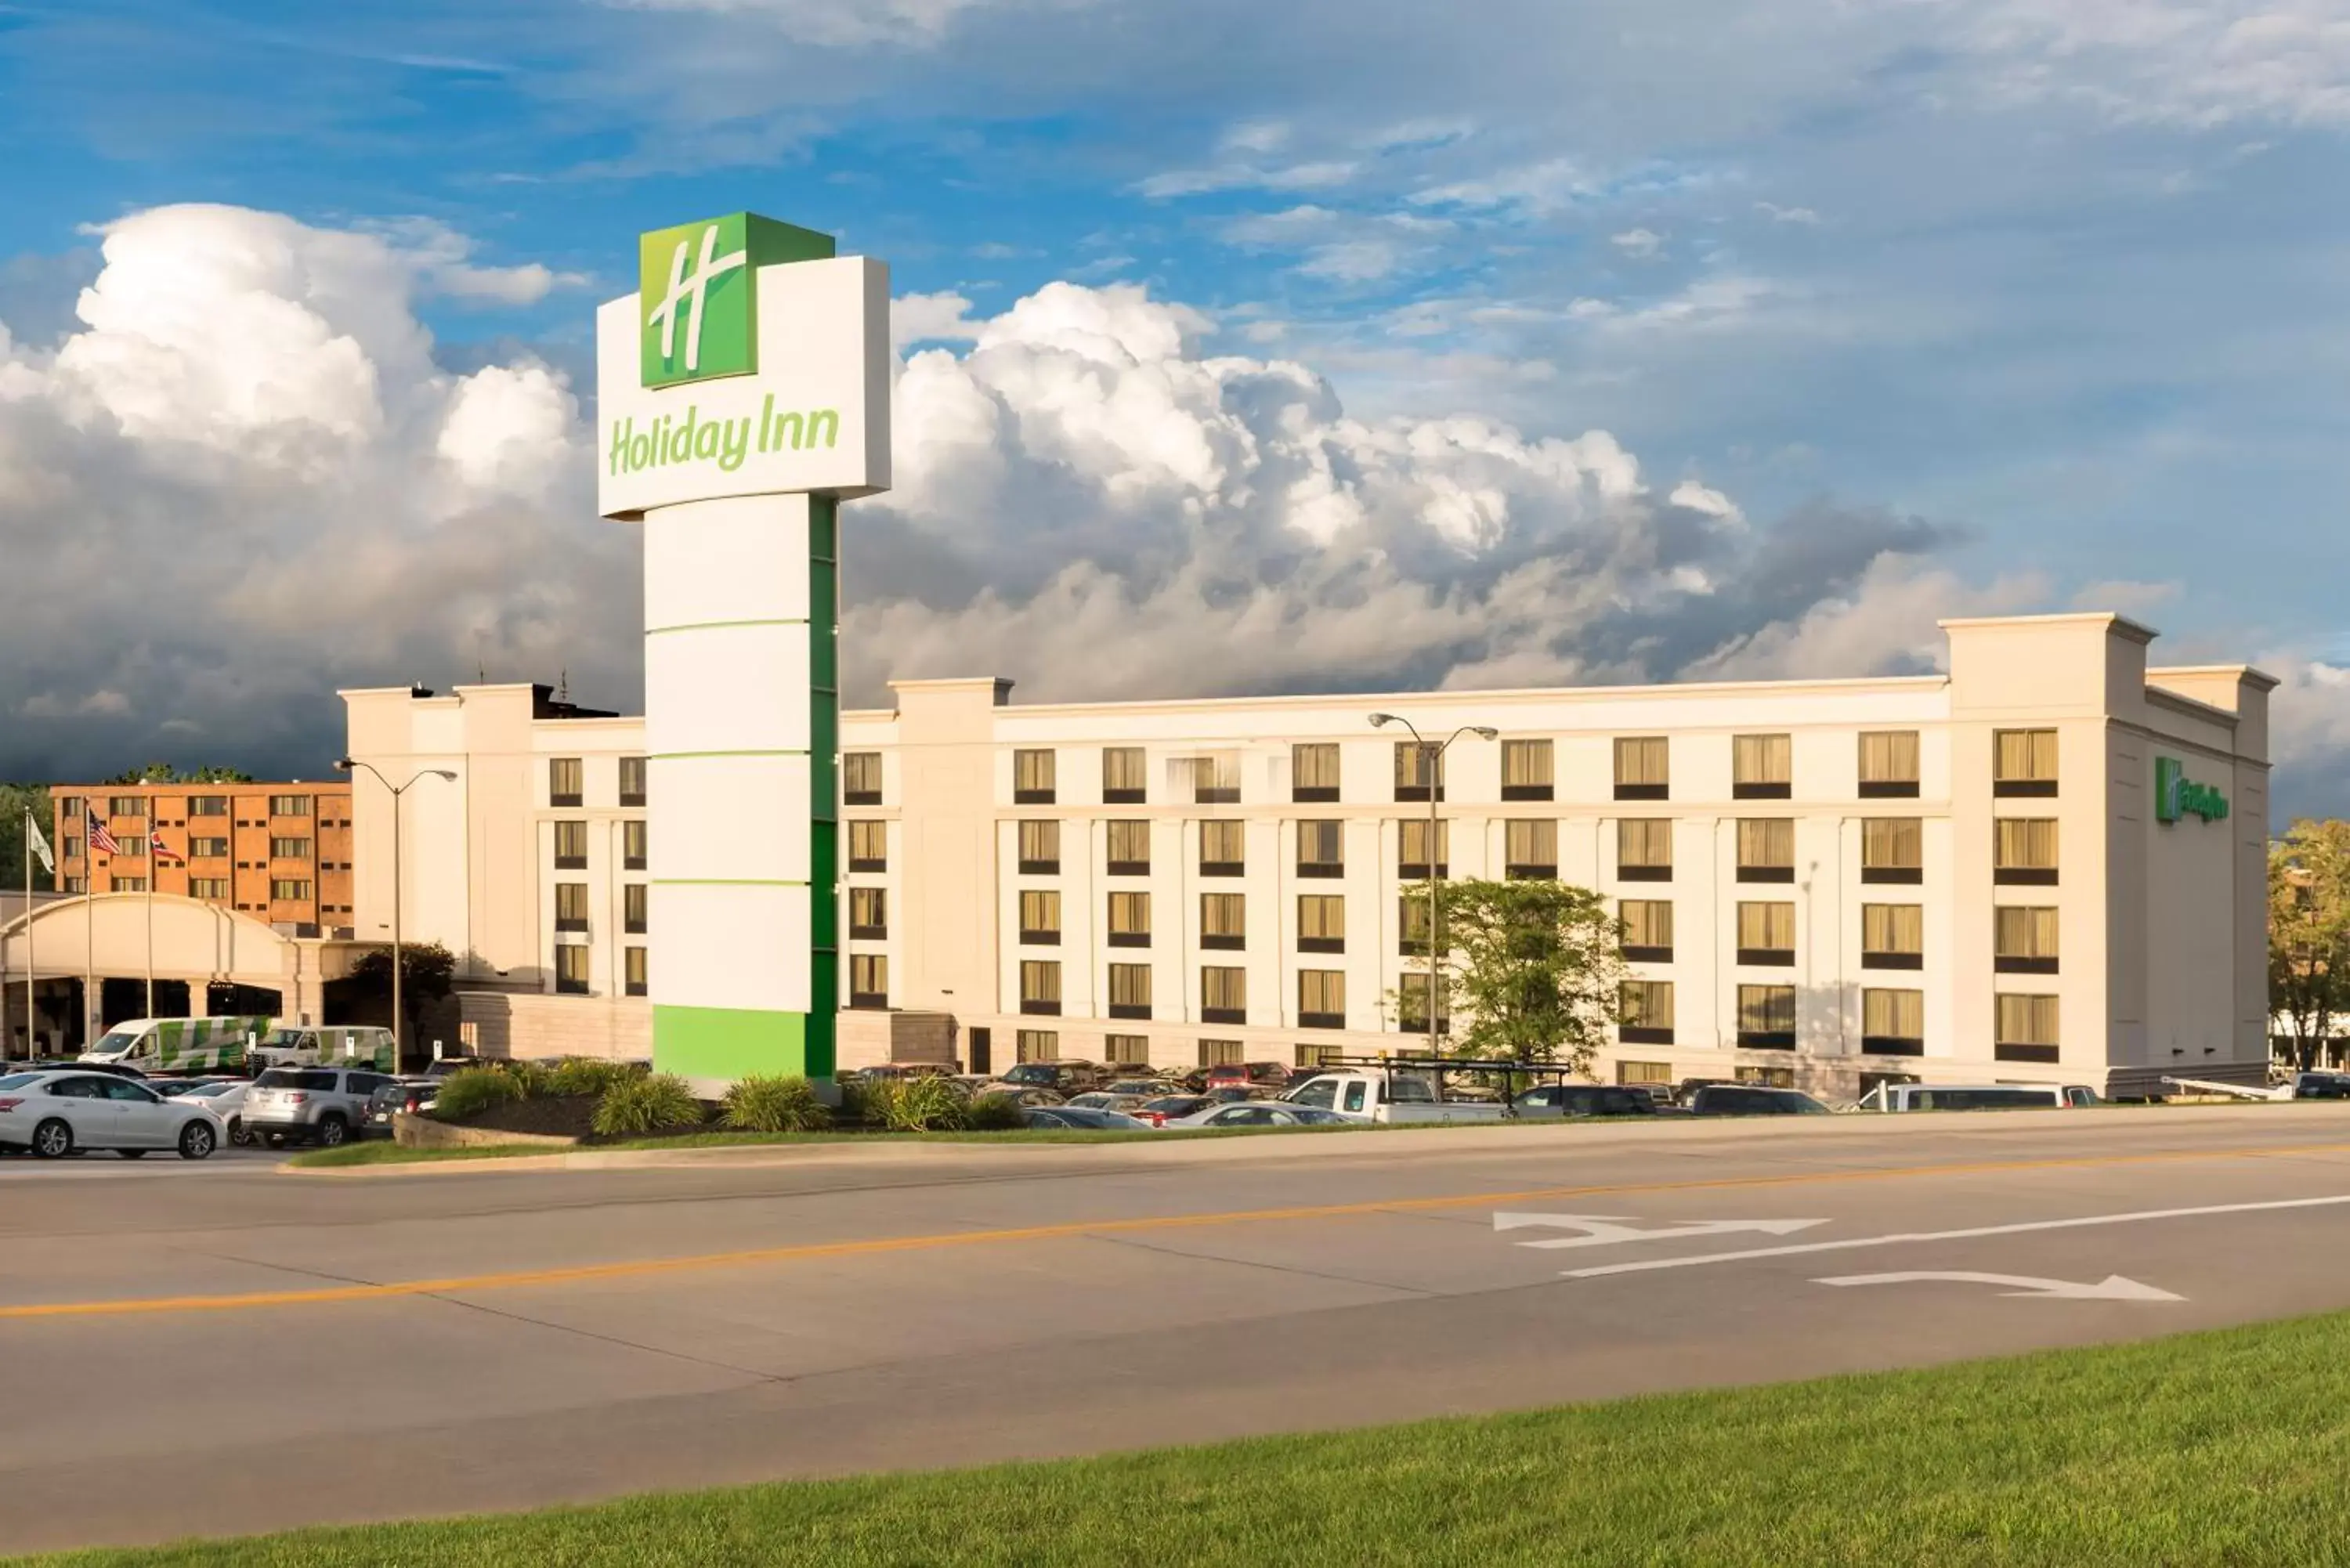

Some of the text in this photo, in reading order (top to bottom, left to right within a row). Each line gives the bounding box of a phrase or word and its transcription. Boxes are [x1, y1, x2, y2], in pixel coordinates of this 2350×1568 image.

[648, 225, 747, 370] H
[609, 393, 841, 477] Holiday Inn
